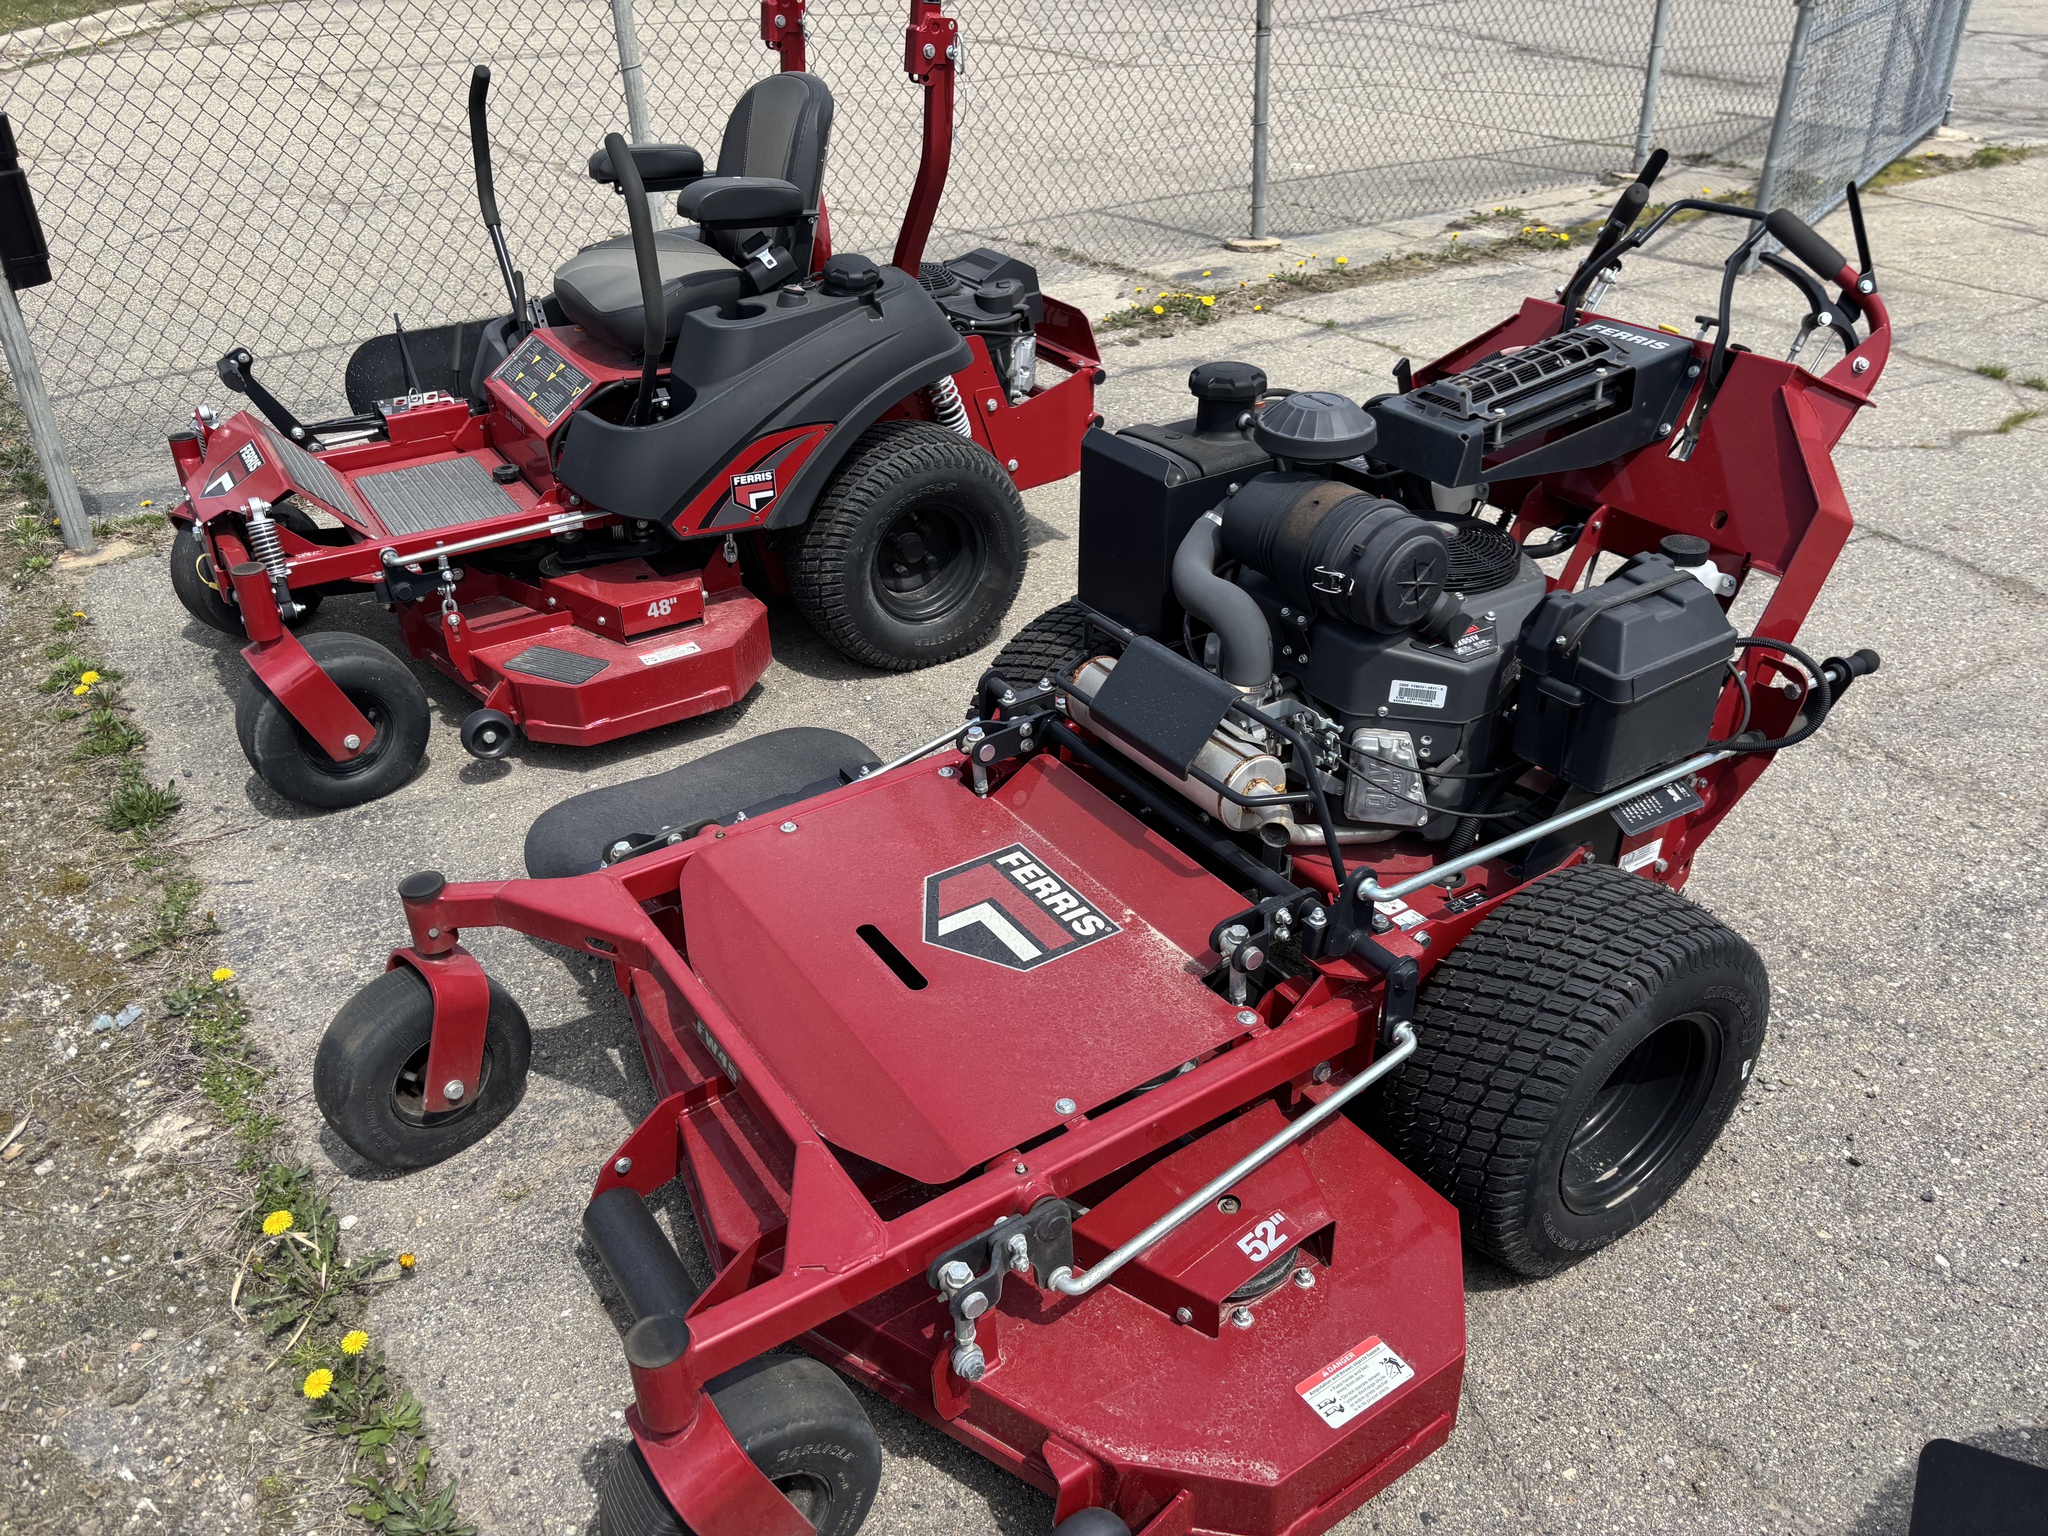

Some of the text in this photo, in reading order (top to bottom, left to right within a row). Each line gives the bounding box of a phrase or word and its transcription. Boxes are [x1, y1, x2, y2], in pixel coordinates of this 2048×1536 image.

[1586, 324, 1670, 350] FERRIS
[239, 443, 262, 472] FERRIS
[733, 471, 773, 486] FERRIS
[647, 597, 677, 618] 48"
[996, 851, 1105, 936] FERRIS
[697, 1020, 738, 1082] FW45
[1236, 1212, 1288, 1262] 52"
[1326, 1351, 1356, 1373] DANGER
[776, 1443, 855, 1463] CARLISLE
